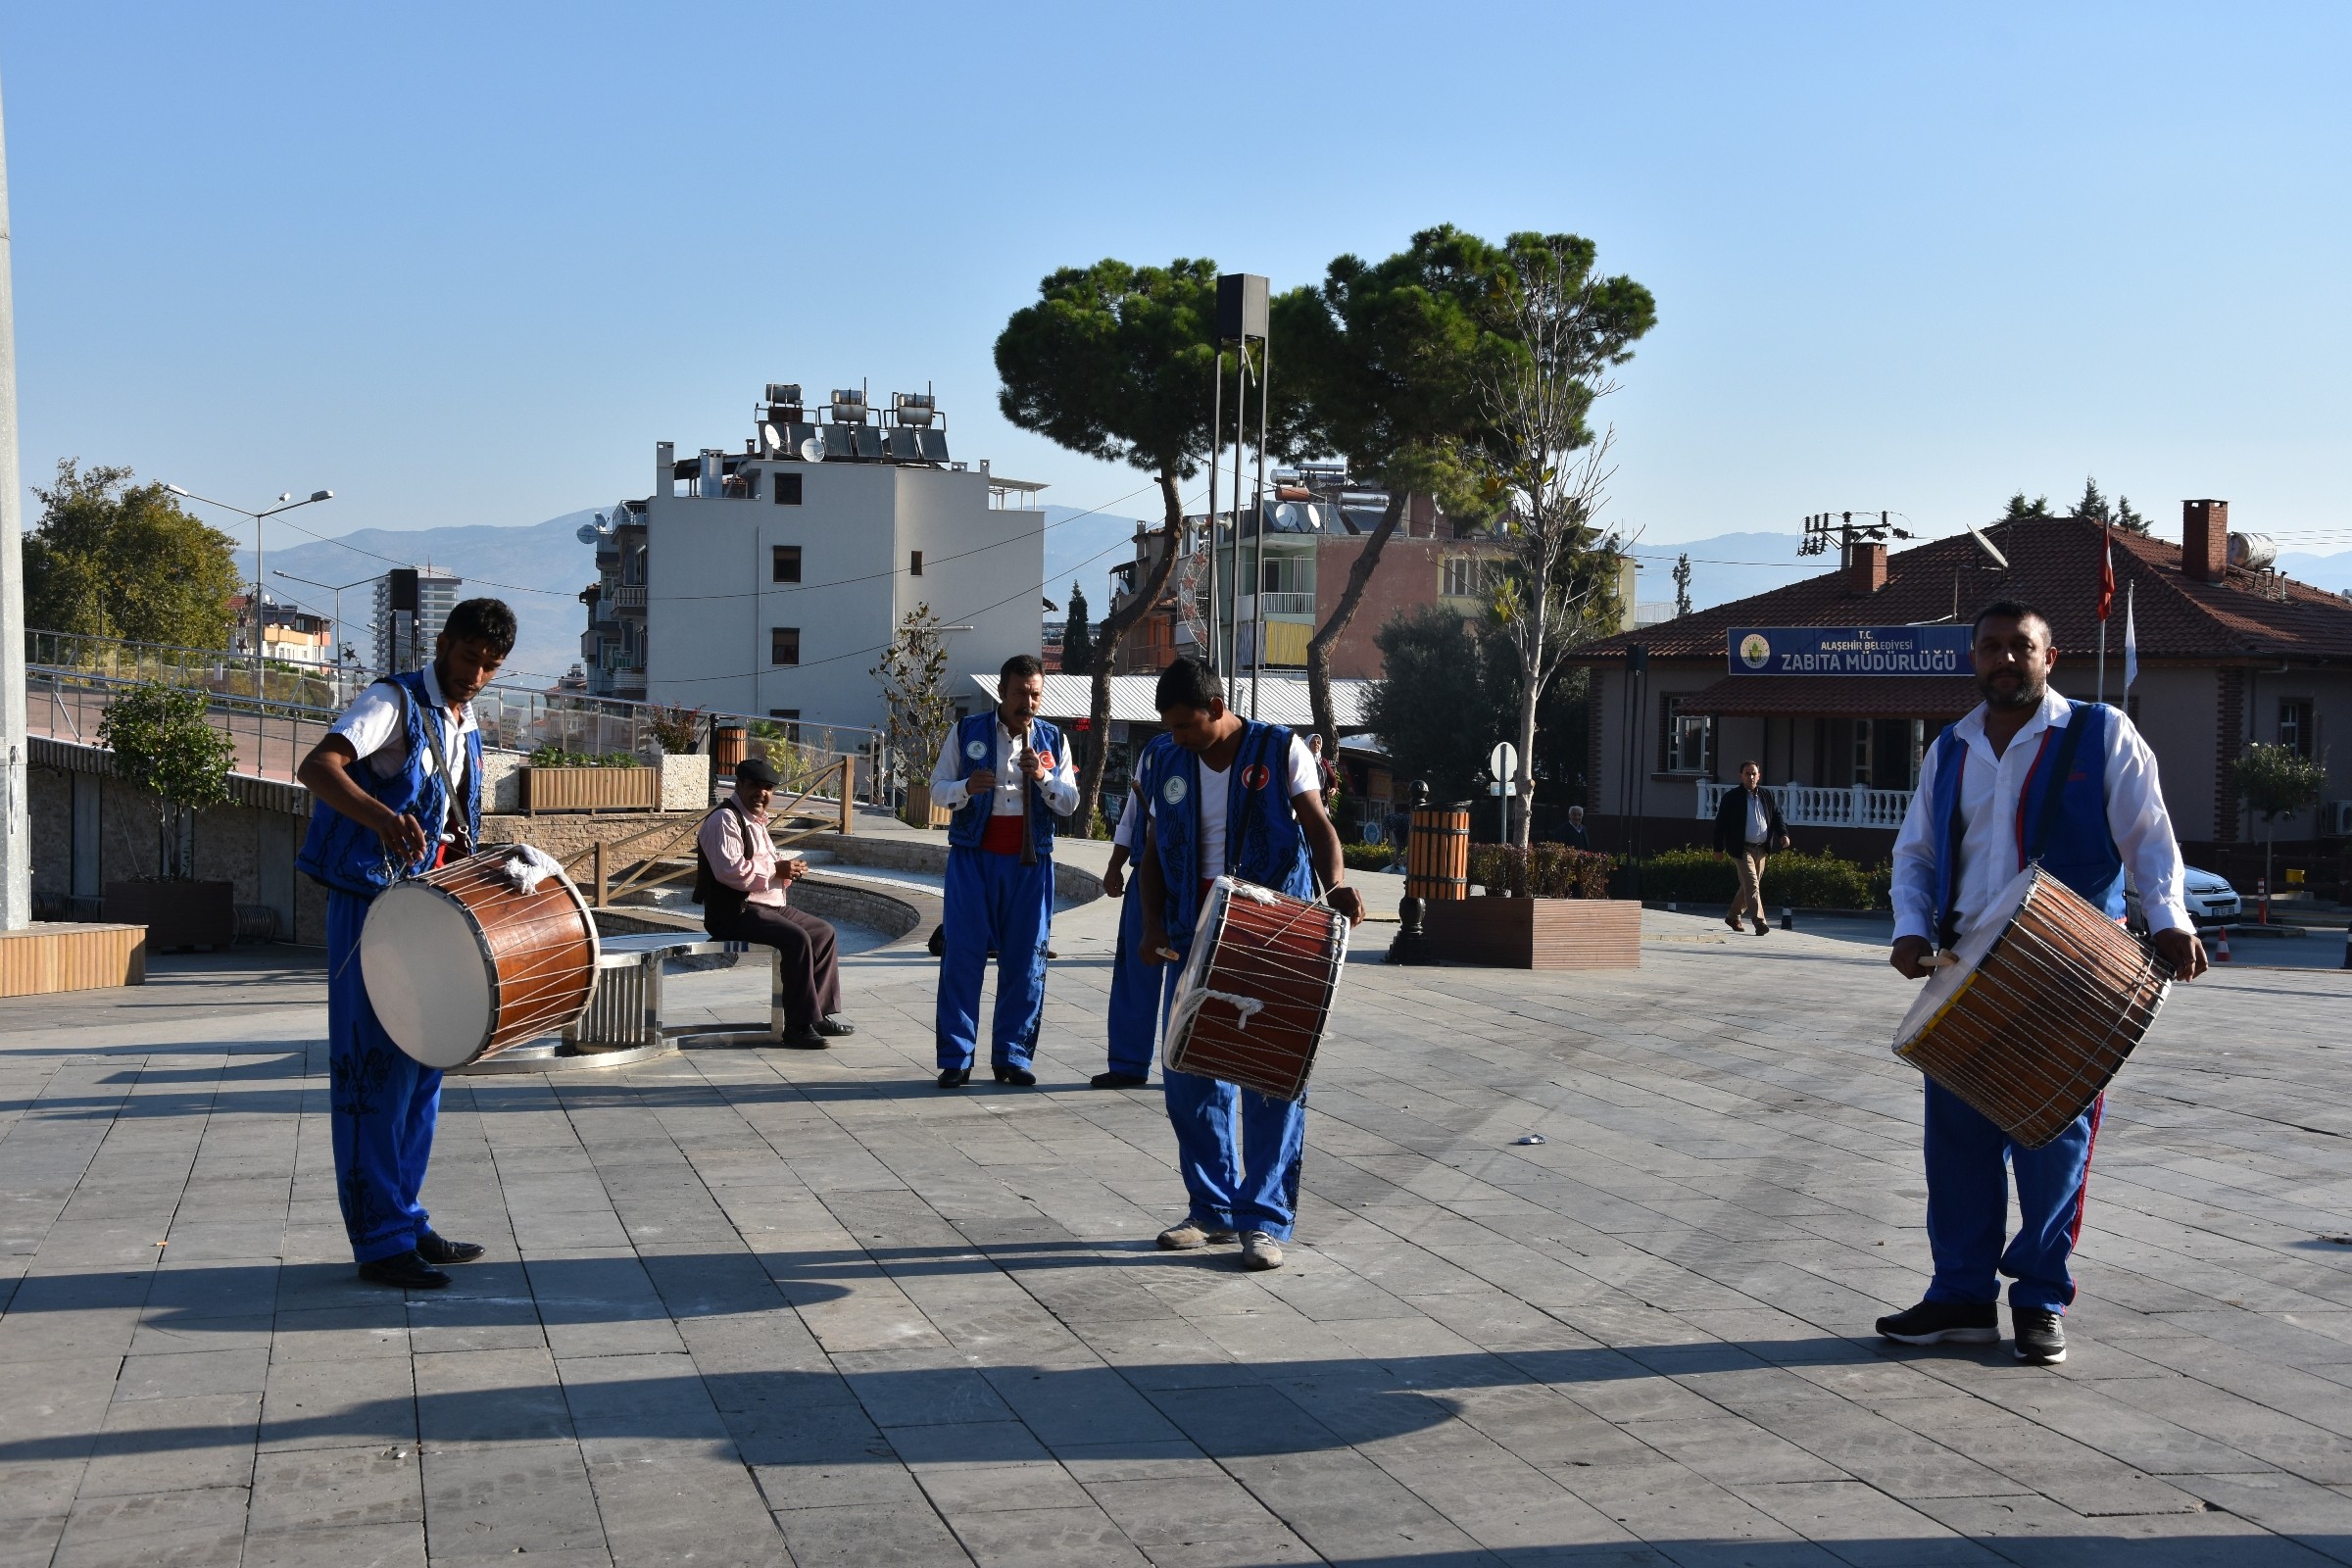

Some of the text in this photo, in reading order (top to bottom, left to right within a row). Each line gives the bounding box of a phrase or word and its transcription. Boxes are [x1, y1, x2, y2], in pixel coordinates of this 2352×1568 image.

[1858, 630, 1873, 639] T.C.
[1821, 639, 1913, 652] ALAŞEHİR BELEDİYESİ
[1781, 654, 1841, 670] ZABITA
[1845, 651, 1956, 671] MÜDÜRLÜĞÜ
